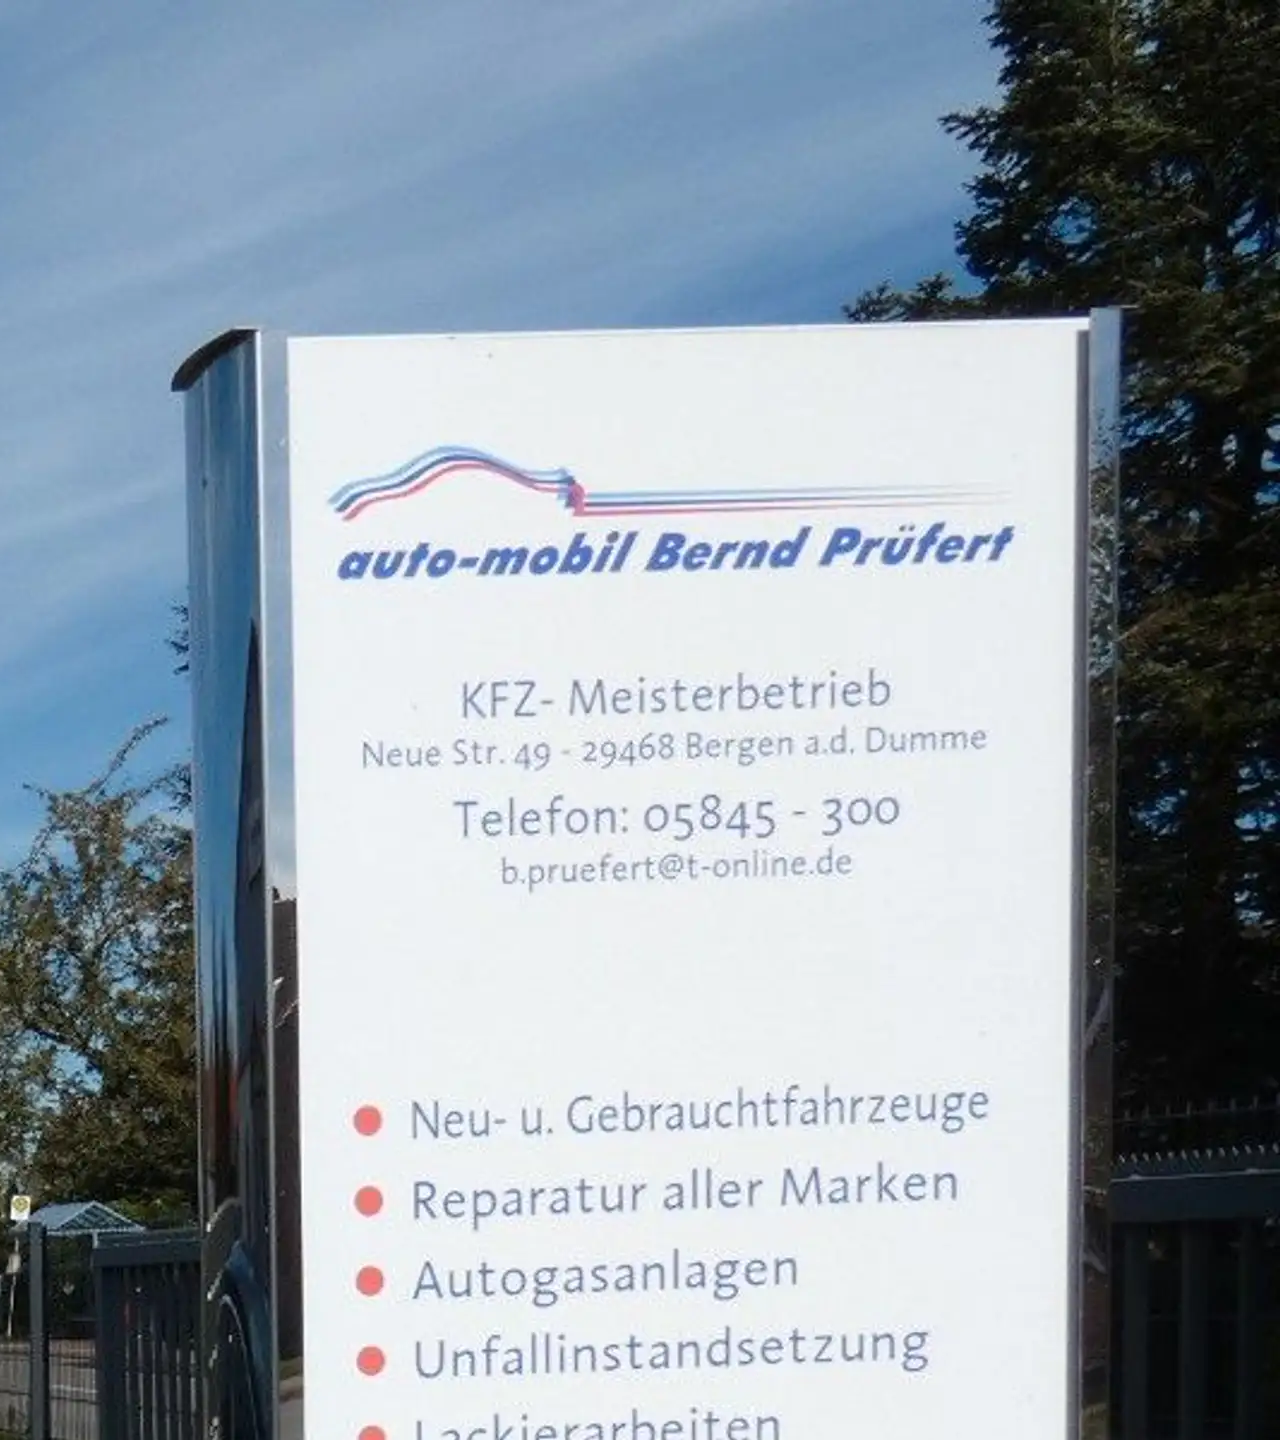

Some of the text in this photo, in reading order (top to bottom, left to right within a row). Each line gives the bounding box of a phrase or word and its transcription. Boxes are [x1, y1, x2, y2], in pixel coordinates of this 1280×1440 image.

[336, 520, 1016, 582] auto-mobil Bernd Prüfert
[462, 667, 891, 720] KFZ- Meisterbetrieb
[362, 740, 442, 769] Neue
[452, 738, 505, 766] Str.
[513, 741, 551, 772] 49
[581, 731, 675, 769] 29468
[686, 731, 794, 767] Bergen
[804, 725, 855, 756] a.d.
[865, 726, 987, 754] Dumme
[452, 794, 629, 839] Telefon:
[643, 793, 776, 842] 05845
[821, 796, 901, 837] 300
[501, 845, 852, 894] b.pruefert@t-online.de
[411, 1083, 990, 1140] Neu- u. Gebrauchtfahrzeuge
[413, 1160, 958, 1232] Reparatur aller Marken
[411, 1247, 798, 1309] Autogasanlagen
[415, 1324, 929, 1380] Unfallinstandsetzung
